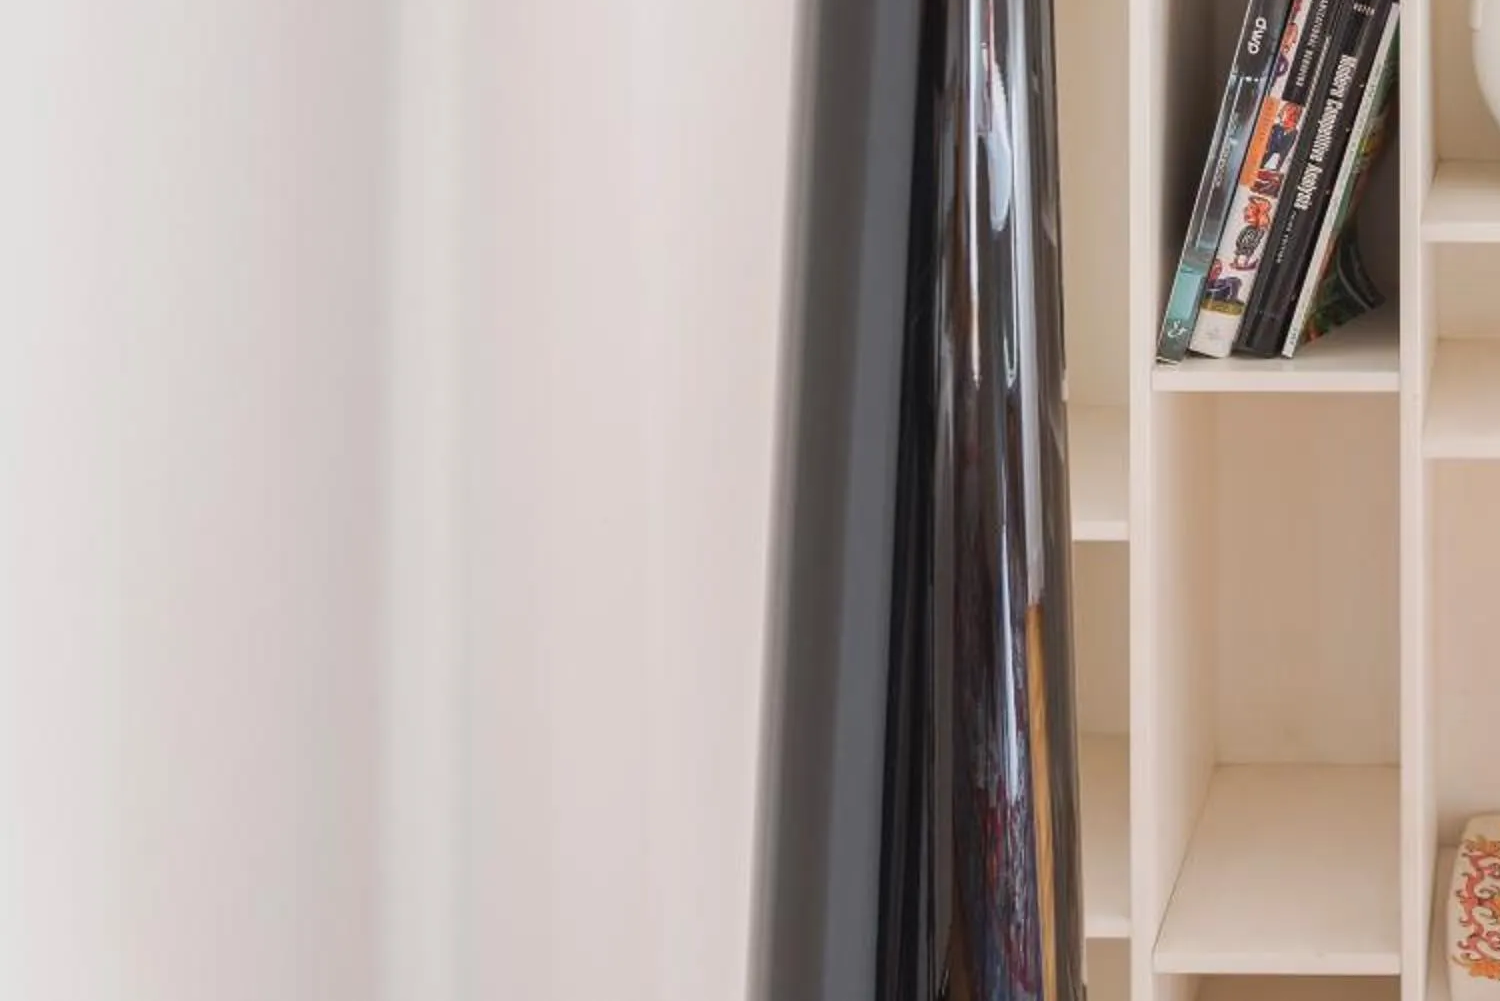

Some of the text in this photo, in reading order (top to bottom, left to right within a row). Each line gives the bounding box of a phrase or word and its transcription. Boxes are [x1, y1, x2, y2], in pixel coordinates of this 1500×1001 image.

[1293, 53, 1360, 211] Modern Competitive Analysis
